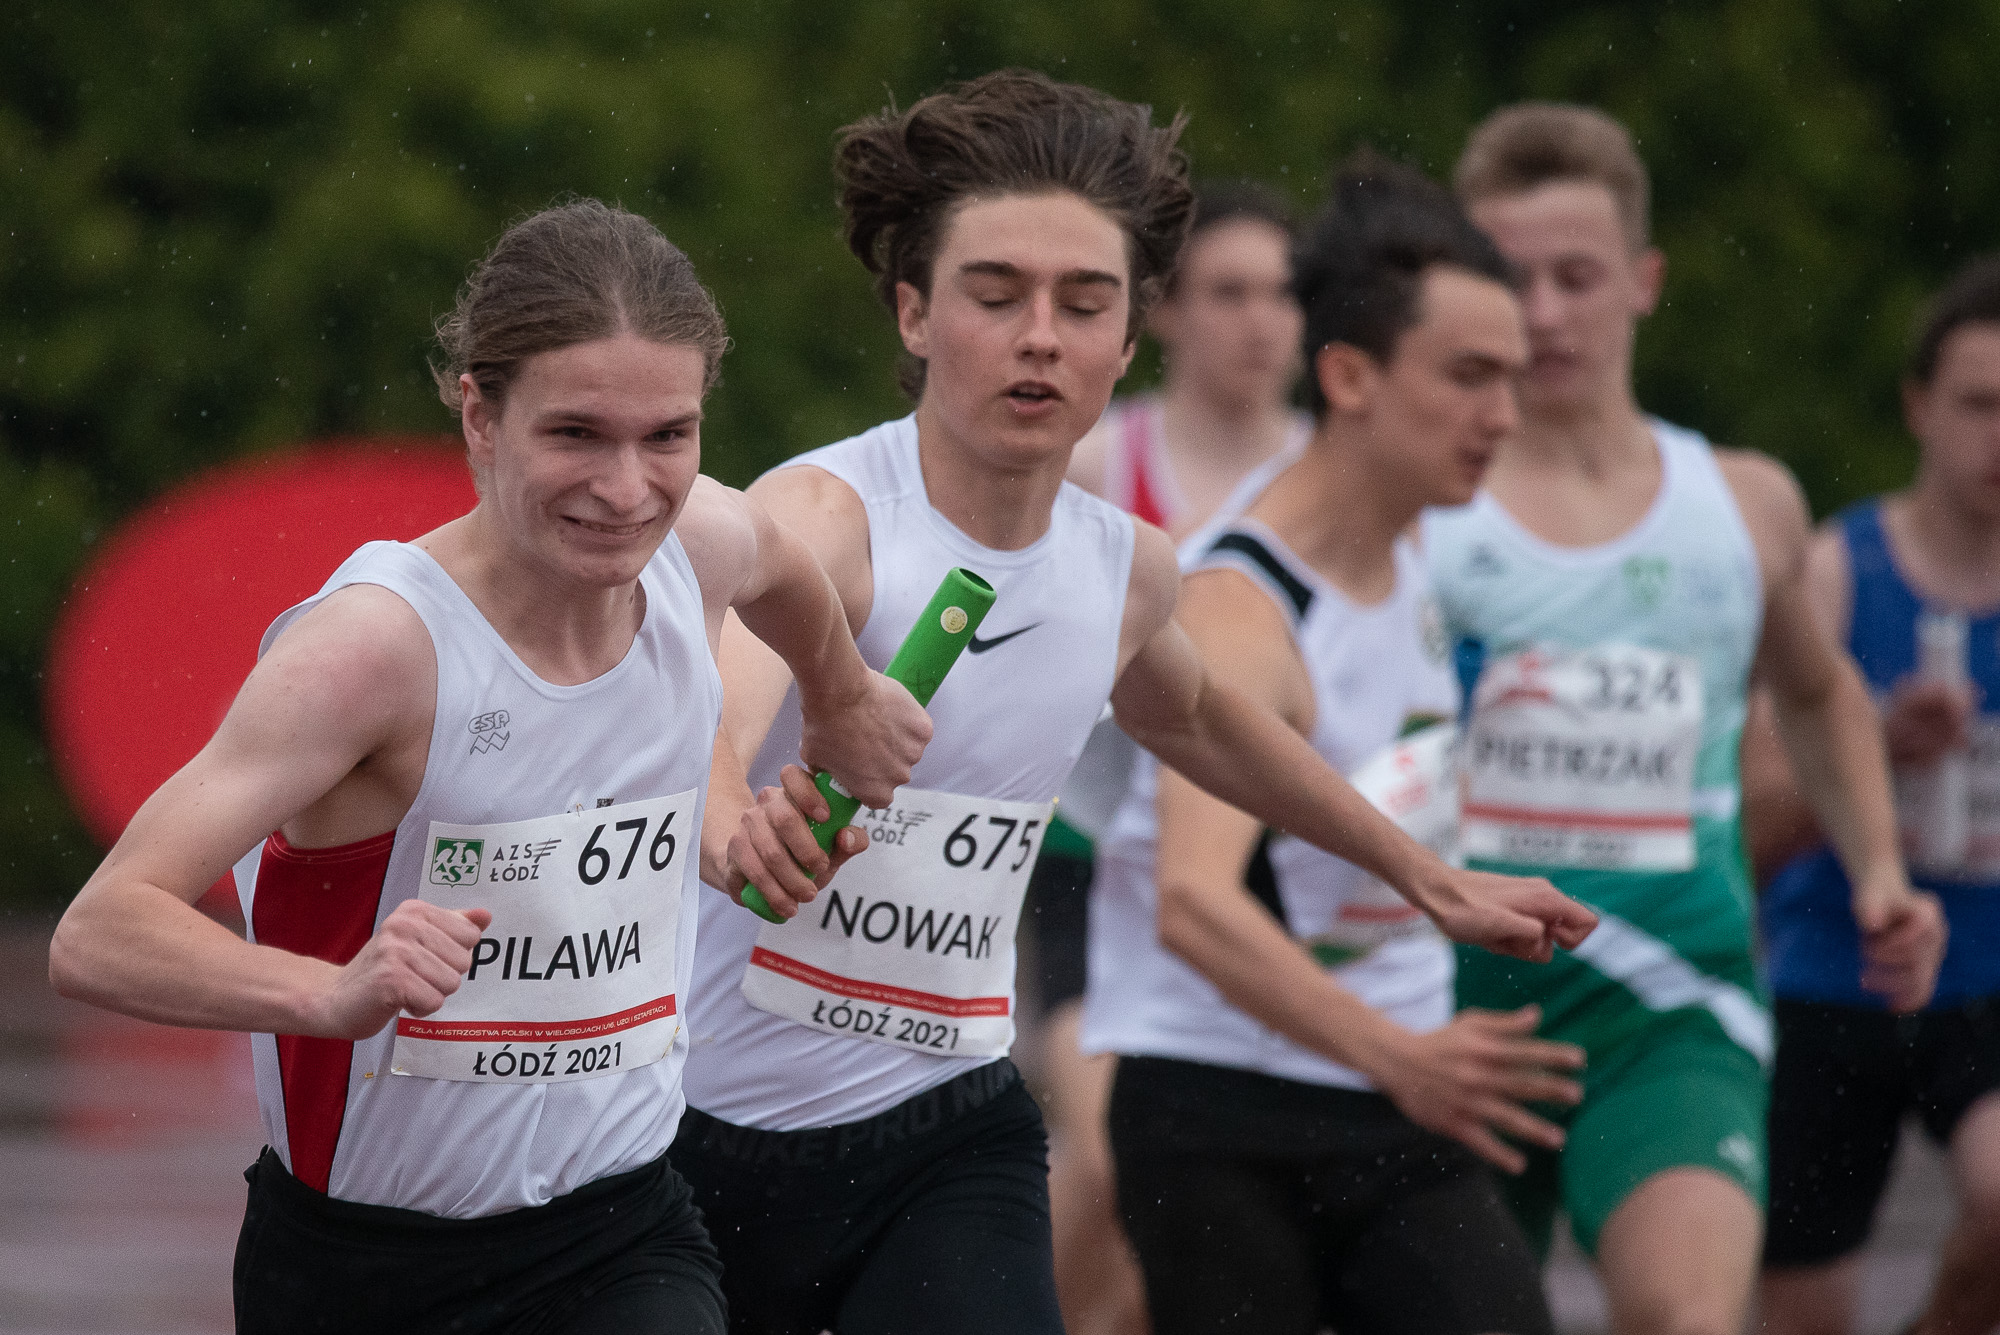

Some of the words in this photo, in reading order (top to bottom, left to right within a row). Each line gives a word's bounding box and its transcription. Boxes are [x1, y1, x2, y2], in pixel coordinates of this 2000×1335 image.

[492, 843, 533, 862] AZS
[578, 811, 677, 886] 676
[863, 823, 908, 846] ÓDŹ
[944, 813, 1040, 873] 675
[489, 862, 540, 882] ŁÓDŹ
[820, 889, 1000, 960] NOWAK
[467, 921, 641, 981] PILAWA
[435, 1027, 500, 1037] MISTRZOSTWA
[501, 1029, 533, 1037] POLSKI
[534, 1029, 543, 1037] W
[545, 1025, 601, 1036] WIELOBOJACH
[812, 999, 891, 1038] ŁÓDŹ
[895, 1017, 959, 1050] 2021
[473, 1043, 557, 1077] ŁÓDŹ
[564, 1041, 622, 1075] 2021
